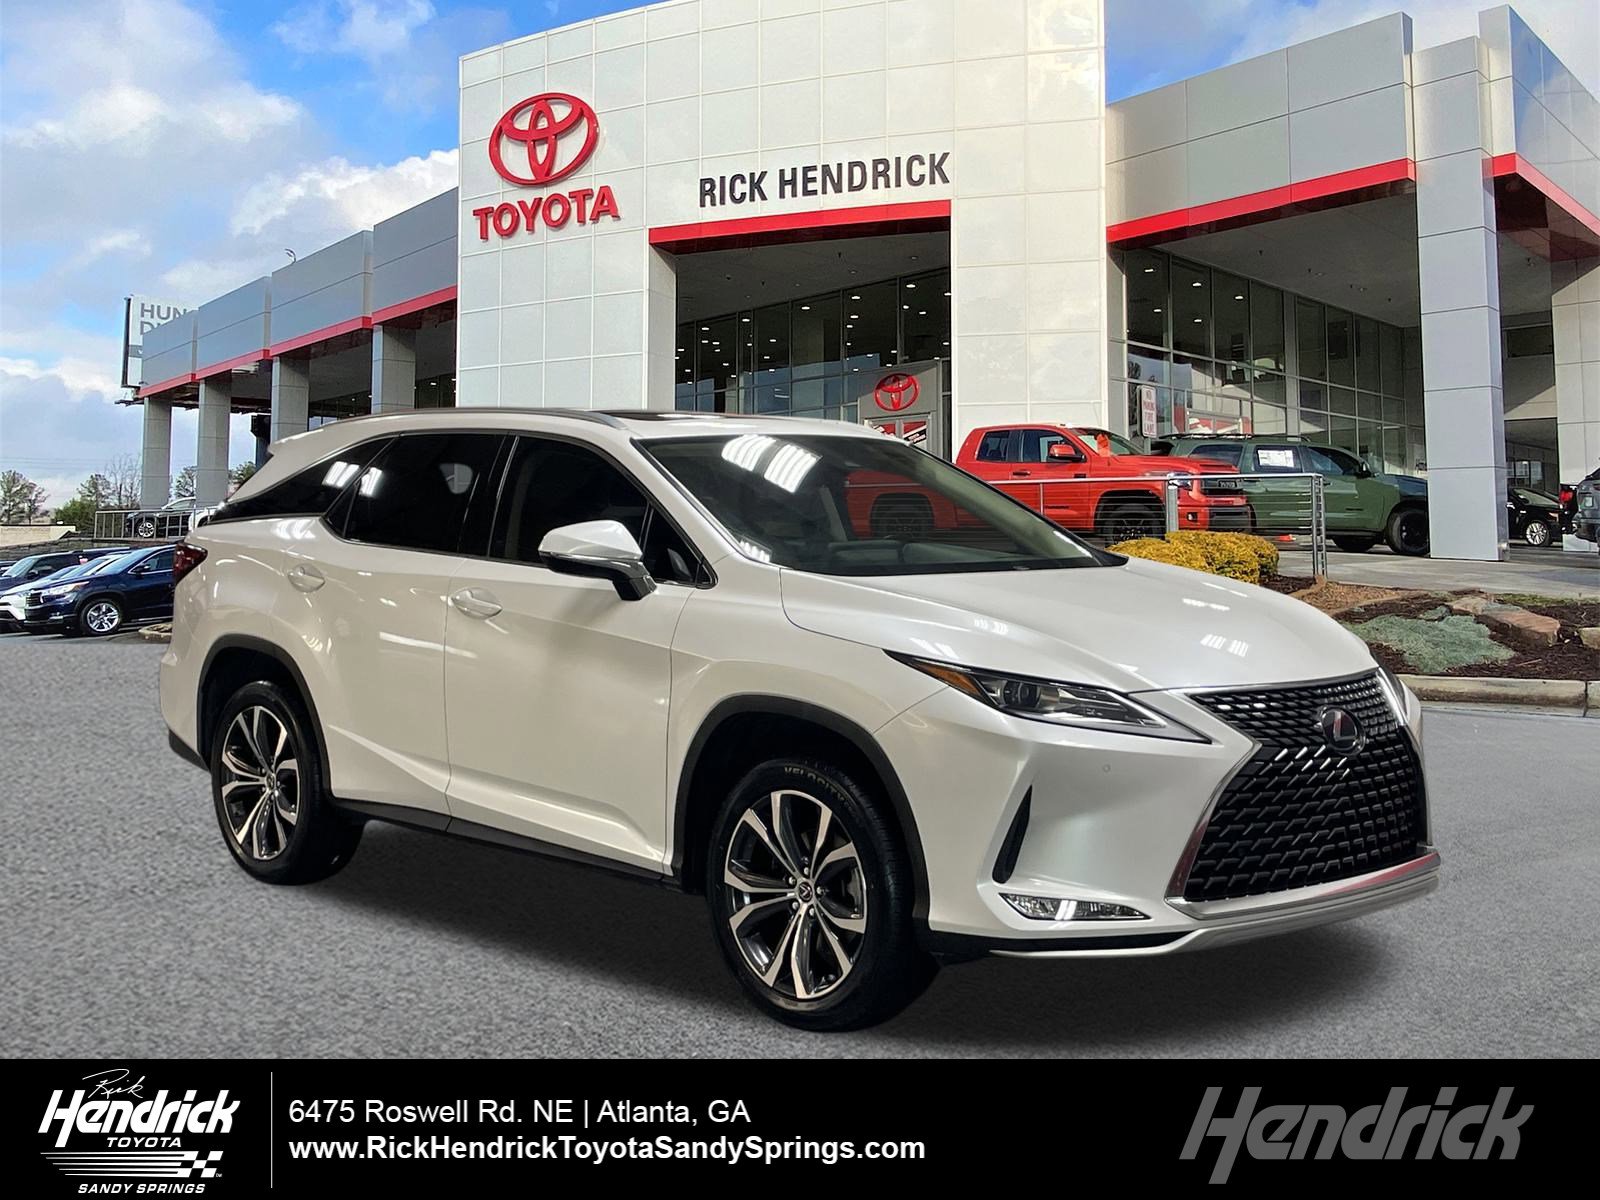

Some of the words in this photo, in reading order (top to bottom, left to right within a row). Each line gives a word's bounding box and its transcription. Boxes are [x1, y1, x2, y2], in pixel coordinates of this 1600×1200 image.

[699, 170, 768, 208] RICK
[778, 152, 951, 199] HENDRICK
[472, 185, 620, 240] TOYOTA
